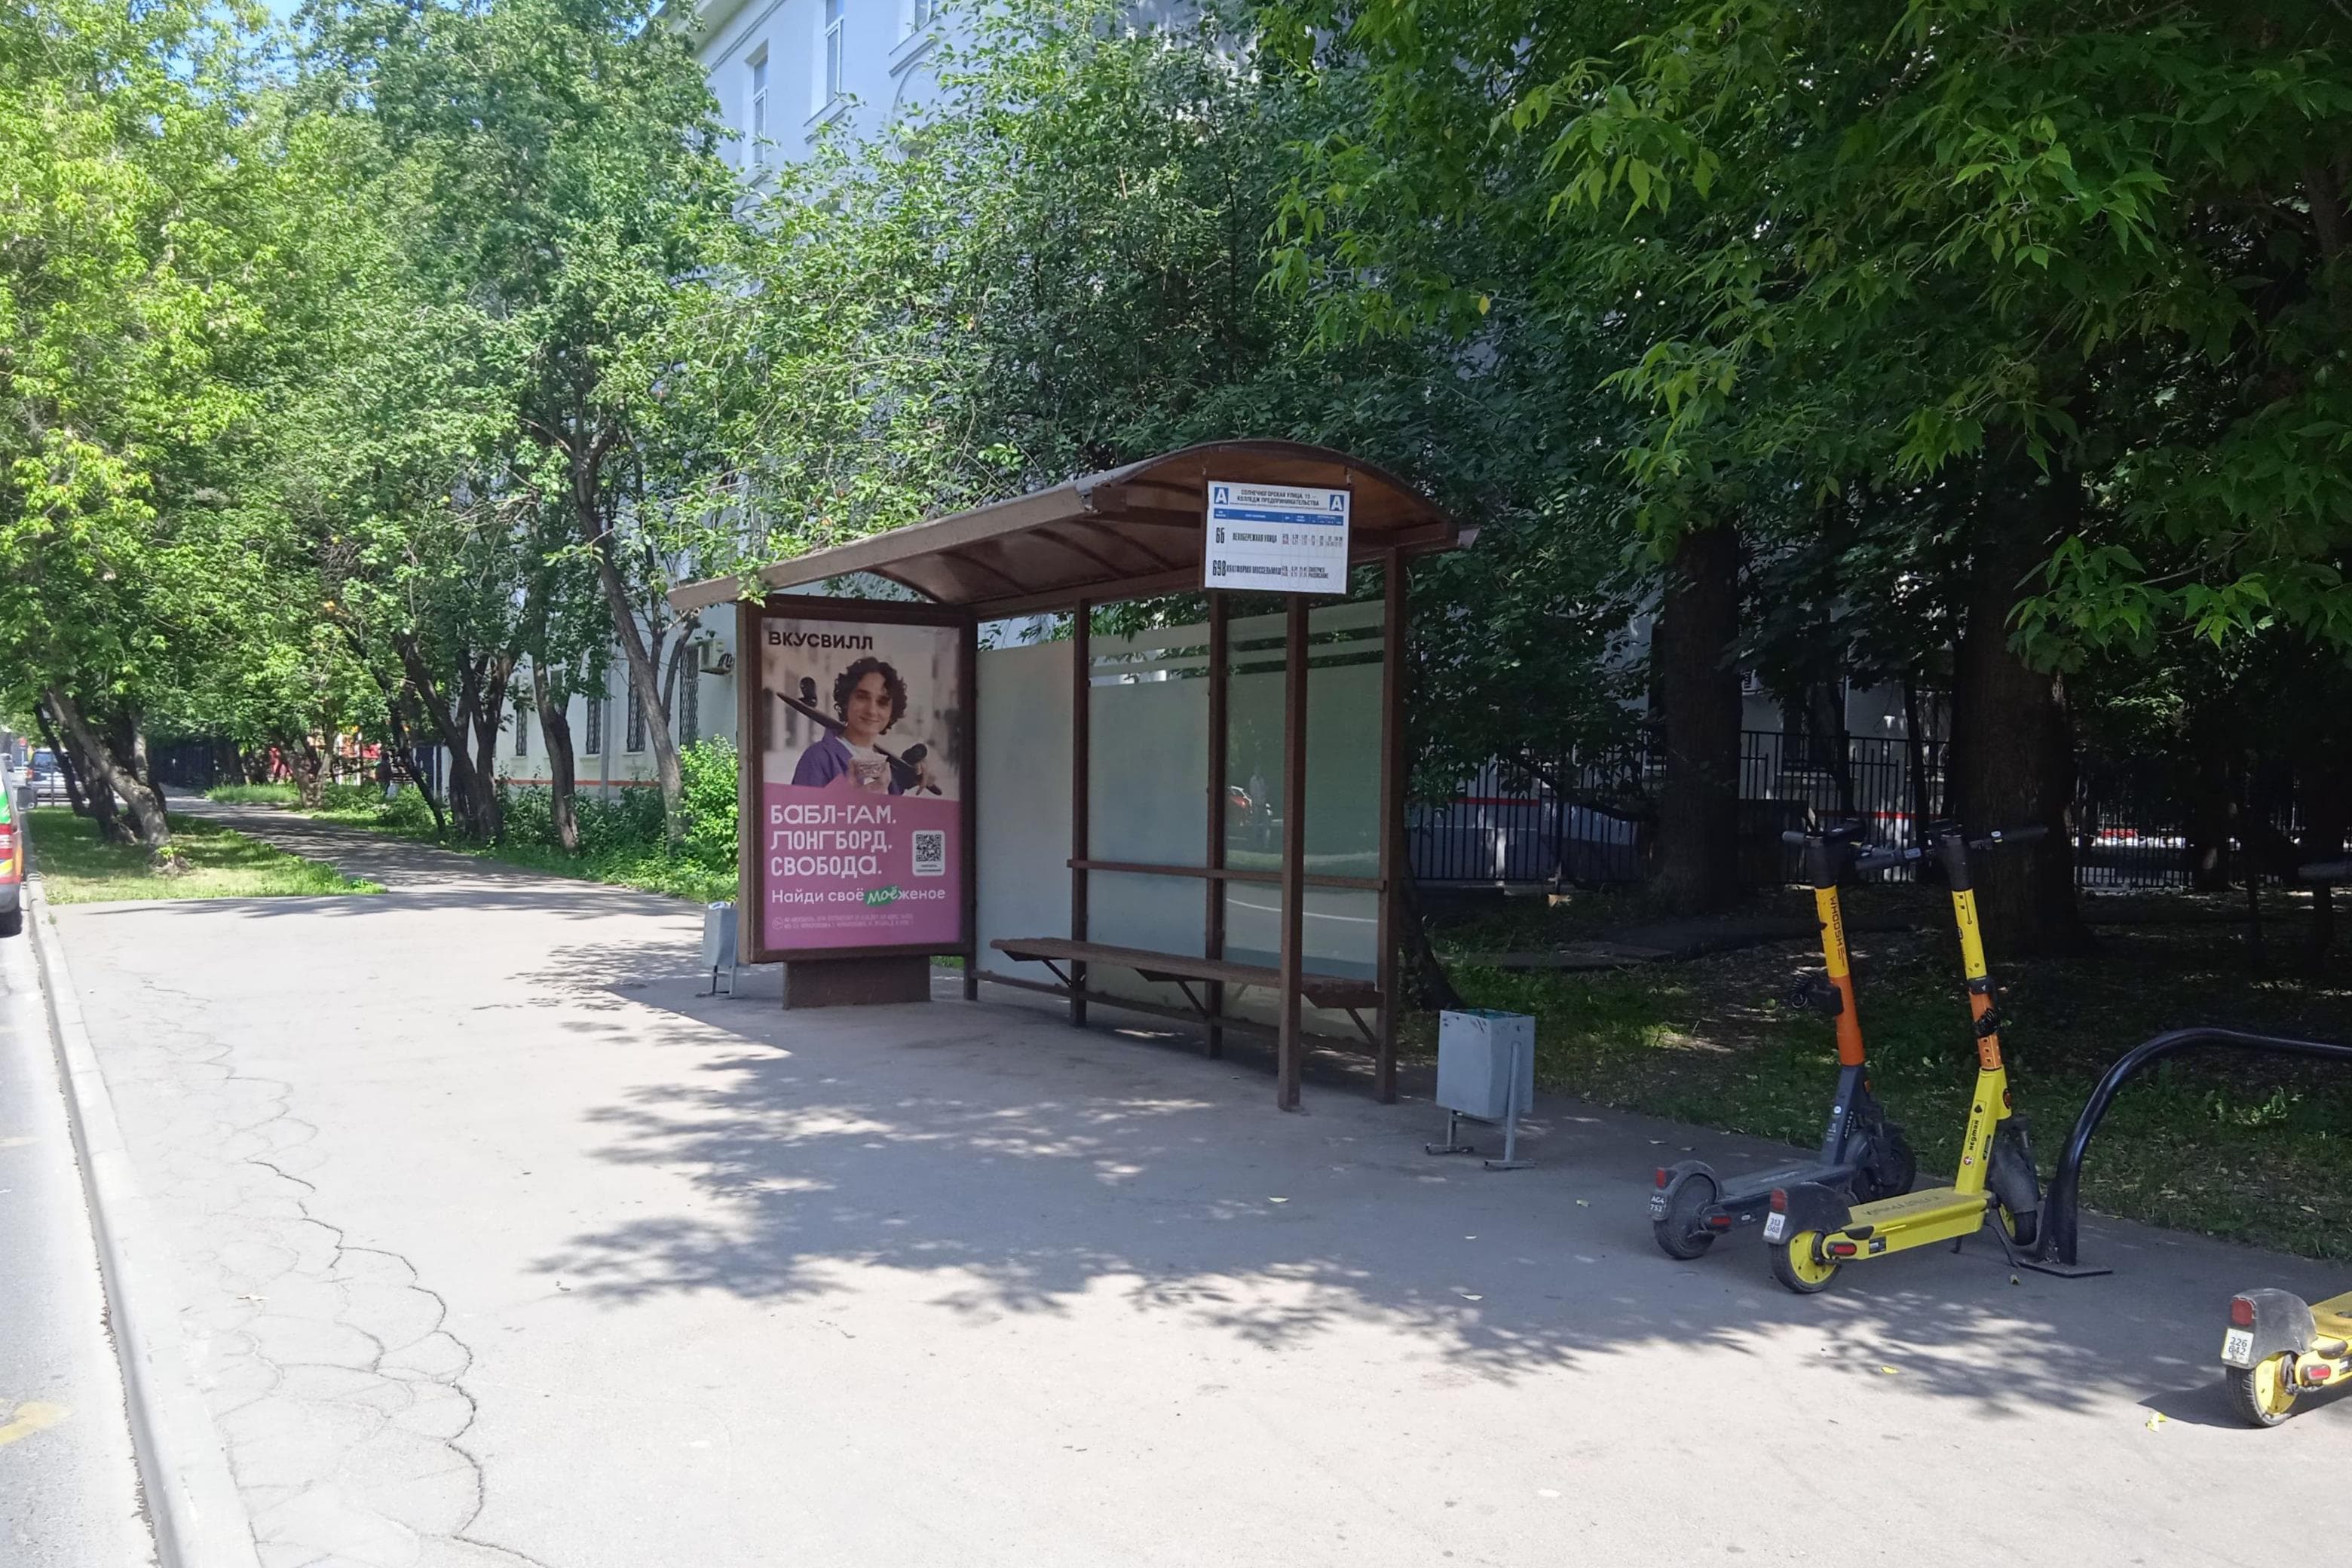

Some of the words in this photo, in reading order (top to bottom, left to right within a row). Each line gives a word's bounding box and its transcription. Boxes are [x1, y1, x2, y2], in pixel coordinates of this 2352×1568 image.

[1212, 560, 1227, 576] 698
[768, 631, 873, 650] ВКУСВИЛЛ
[770, 830, 892, 853] ЛОНГБОРД.
[771, 889, 824, 904] Найди
[828, 888, 864, 902] своё
[1830, 896, 1844, 947] WHOOSH
[2230, 1337, 2248, 1348] 226
